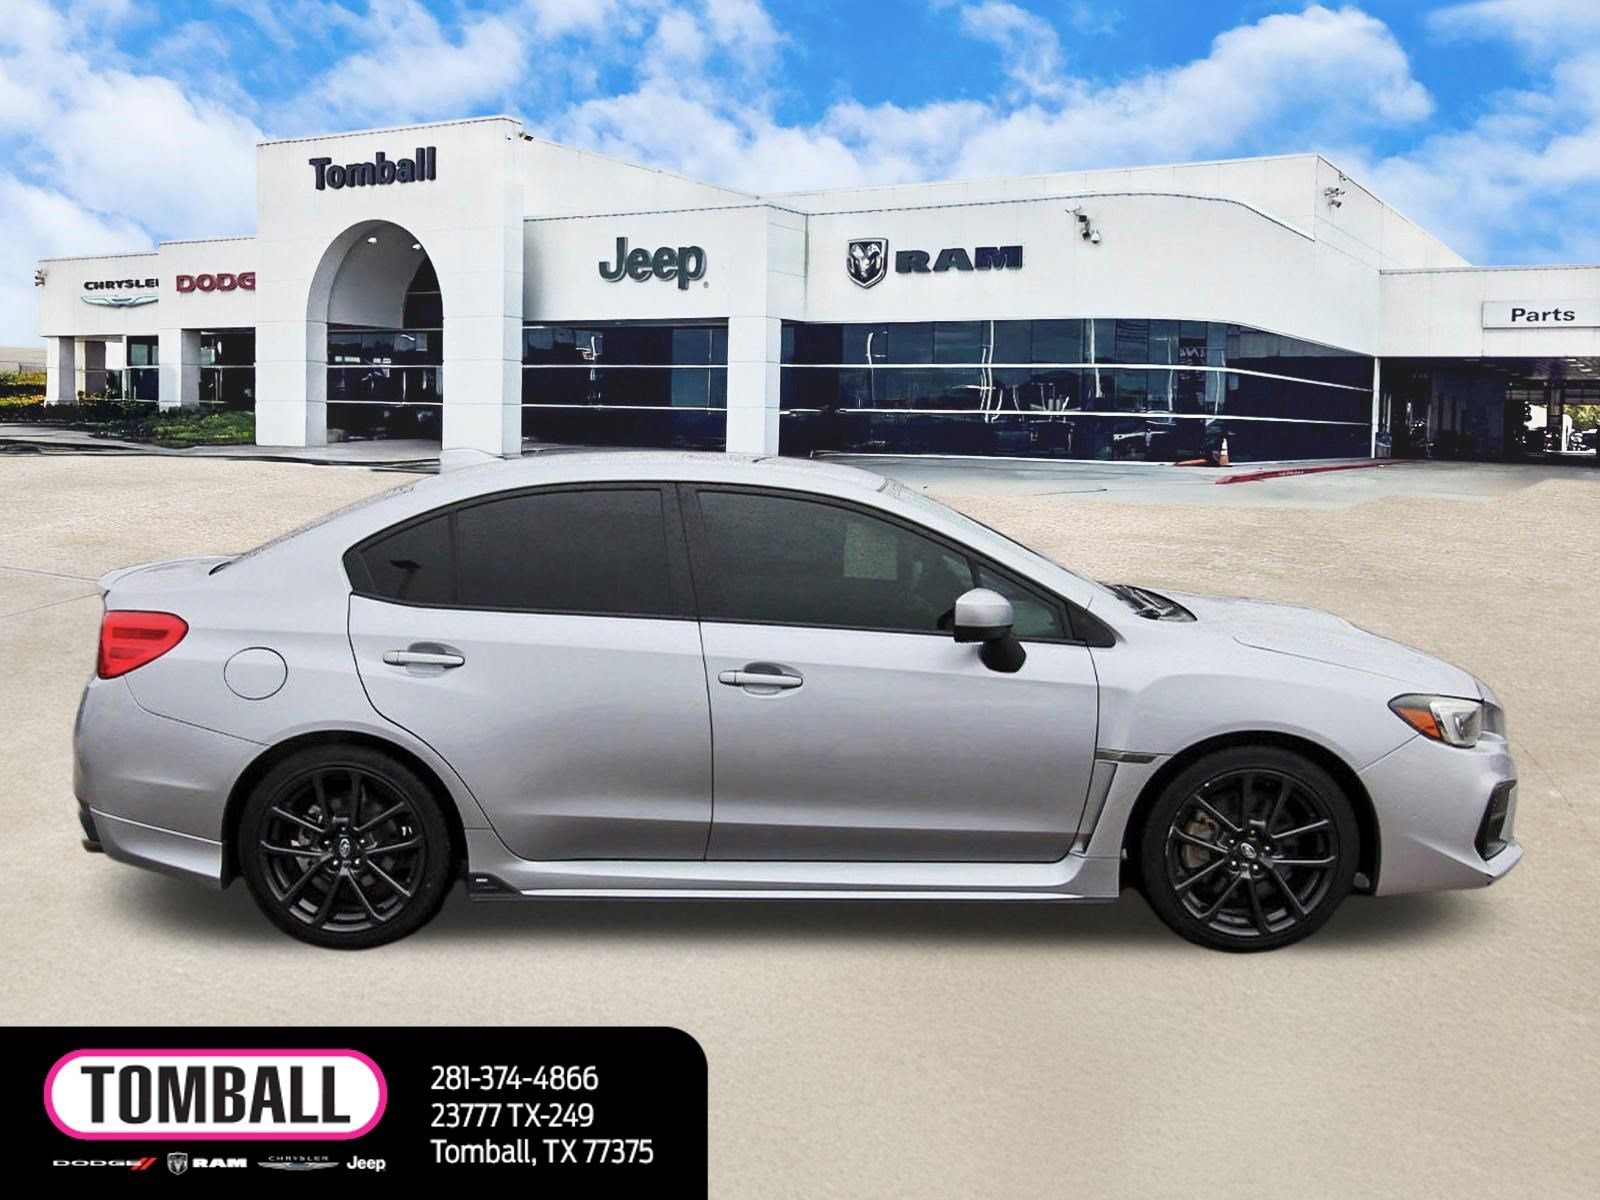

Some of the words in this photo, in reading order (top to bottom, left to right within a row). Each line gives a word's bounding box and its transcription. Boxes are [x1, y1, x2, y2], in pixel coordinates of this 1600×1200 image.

[308, 146, 437, 190] Tomball
[598, 237, 707, 290] Jeep
[895, 245, 1023, 274] RAM
[84, 278, 159, 290] CHRYSLE
[176, 271, 256, 293] DODG
[1511, 307, 1576, 323] Parts
